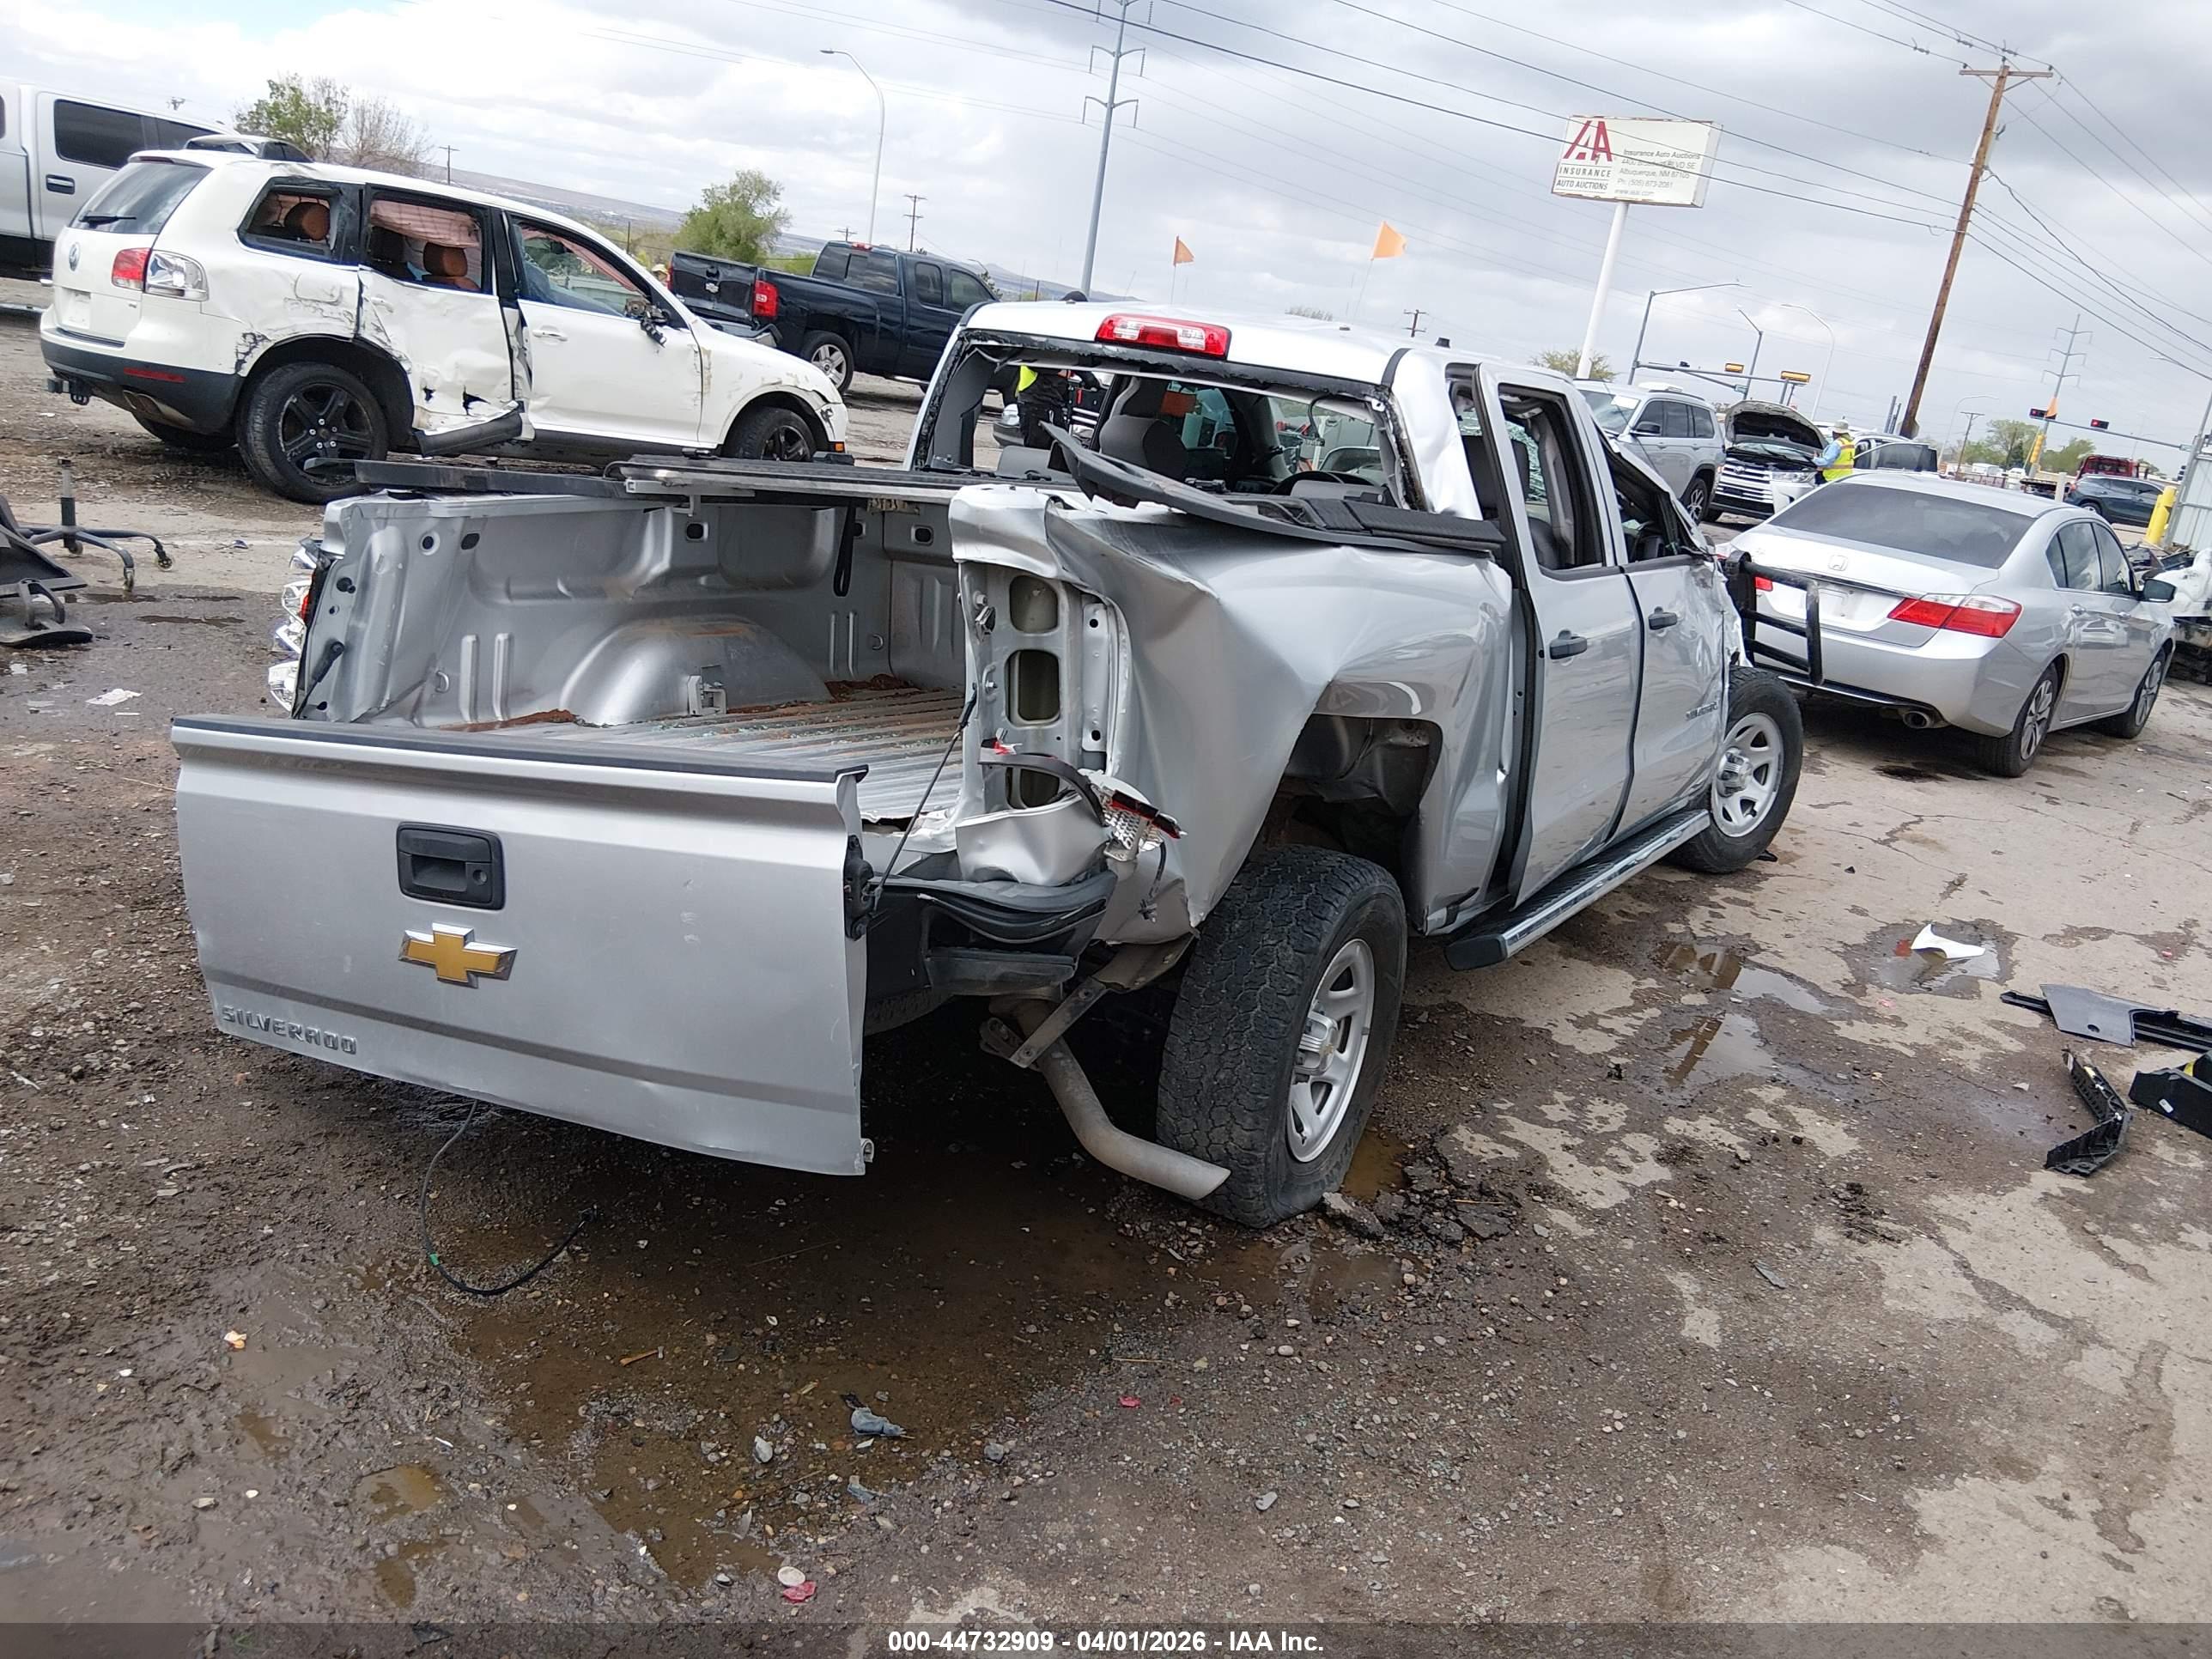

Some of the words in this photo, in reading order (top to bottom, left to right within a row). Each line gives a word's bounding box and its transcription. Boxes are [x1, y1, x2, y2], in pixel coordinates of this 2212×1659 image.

[1623, 149, 1655, 157] Insurance
[1671, 151, 1701, 160] Auctions
[1559, 167, 1612, 178] INSURANCE
[1556, 179, 1575, 188] AUTO
[1575, 181, 1608, 191] AUCTIONS
[222, 1005, 357, 1054] SILVERADO
